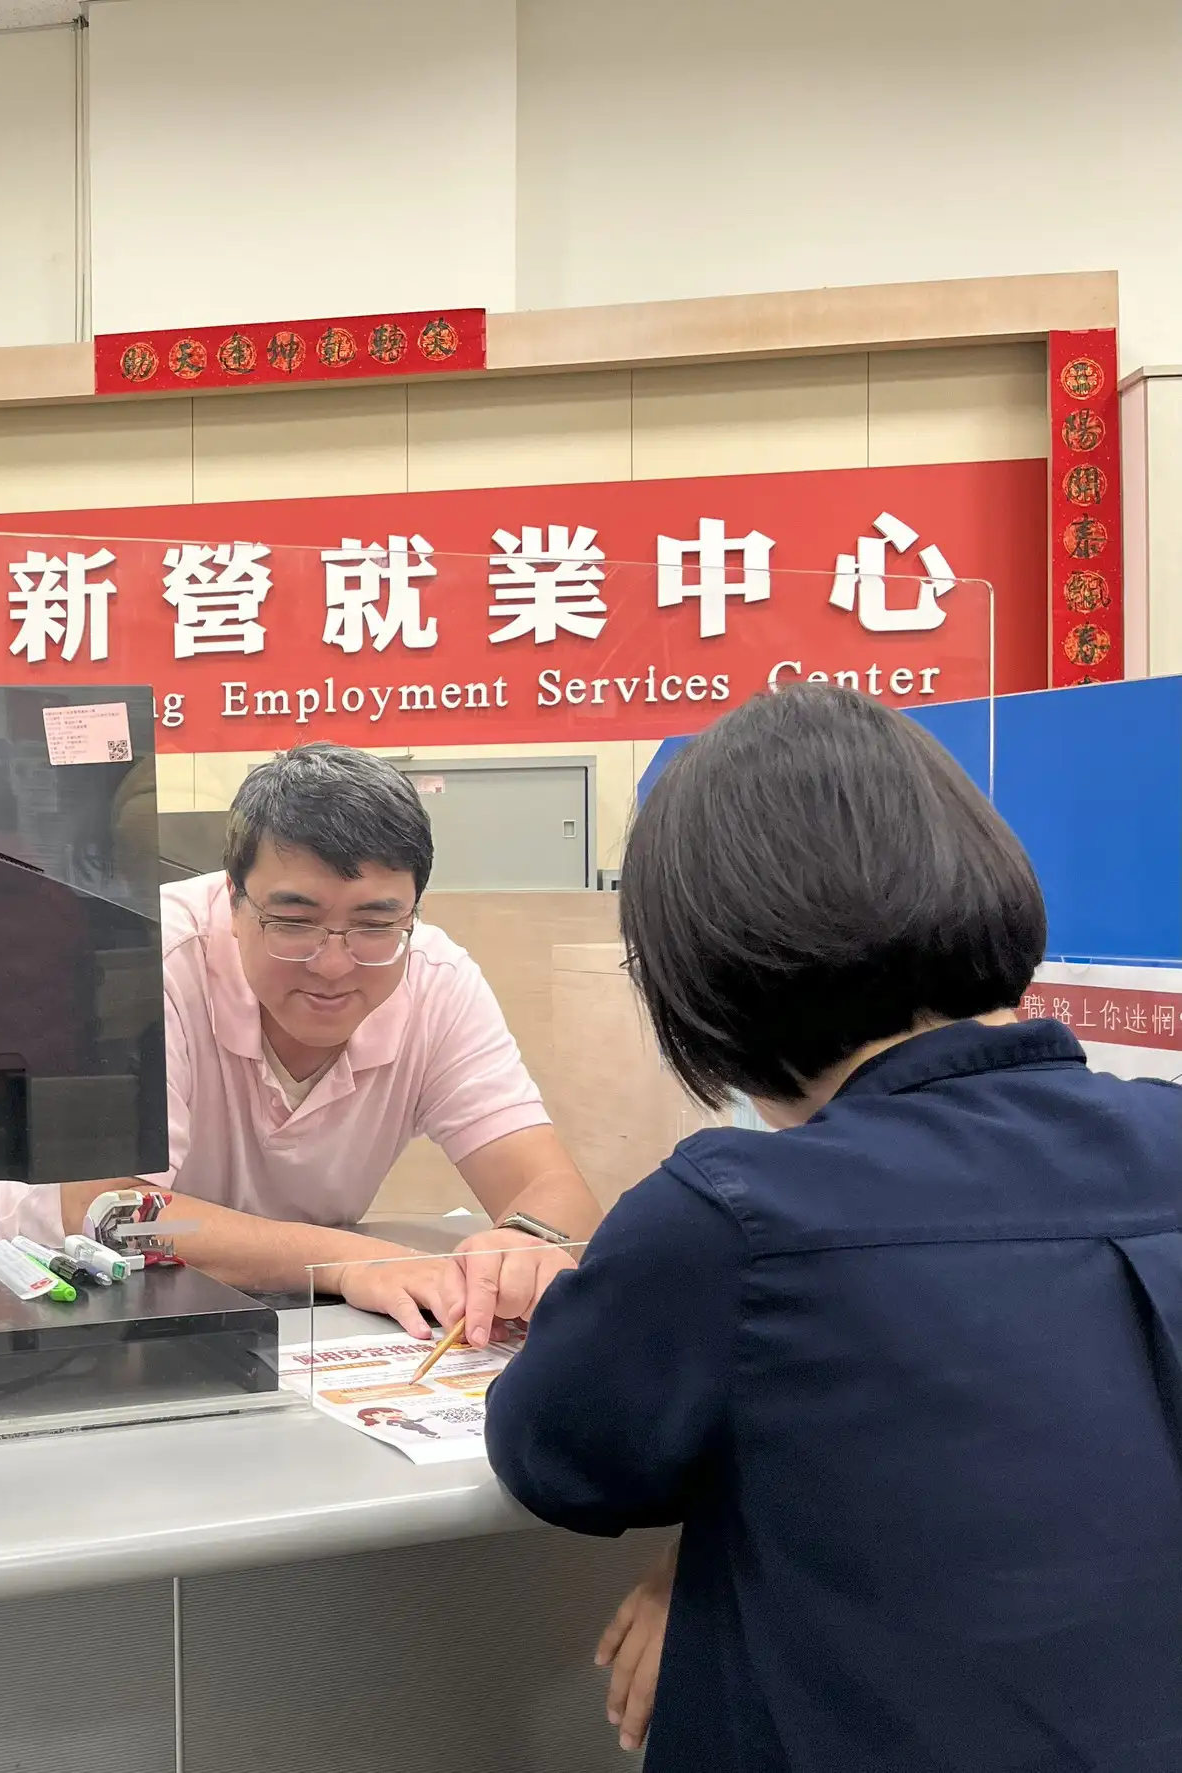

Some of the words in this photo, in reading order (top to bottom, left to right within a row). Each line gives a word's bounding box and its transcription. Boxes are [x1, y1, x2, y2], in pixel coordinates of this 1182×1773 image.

[8, 511, 956, 664] 新營就業中心
[221, 675, 509, 724] Employment
[537, 664, 731, 706] Services
